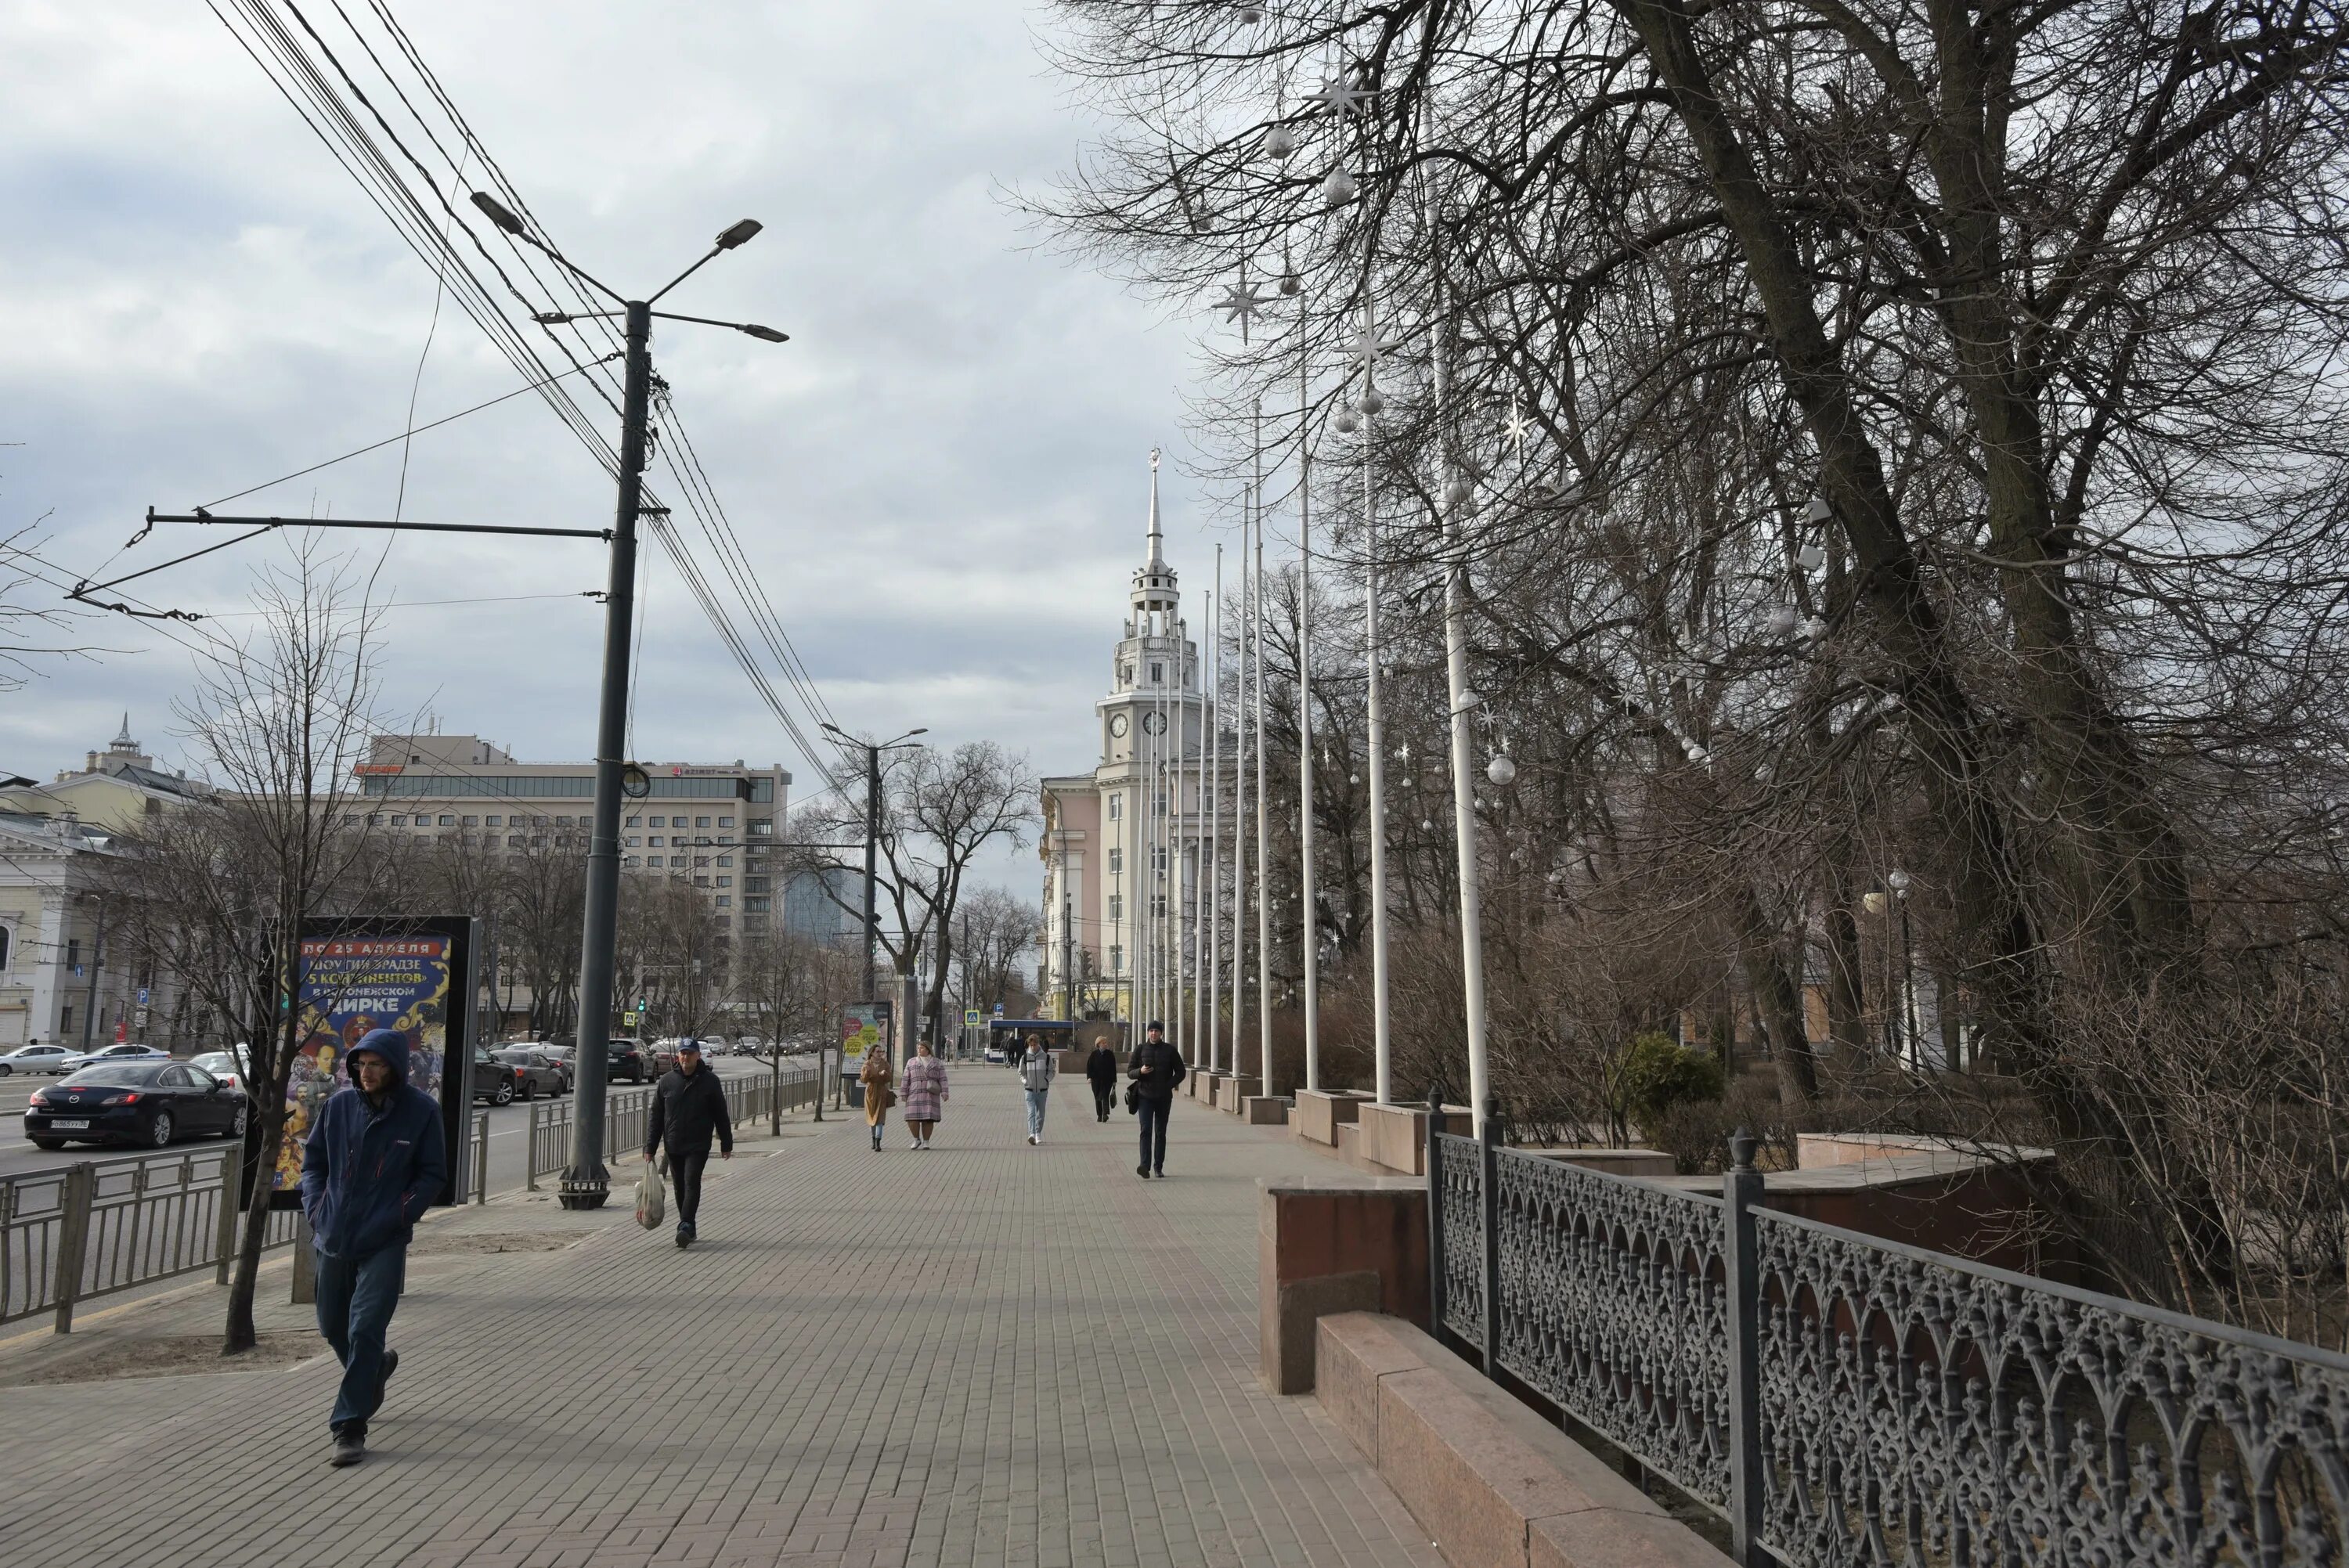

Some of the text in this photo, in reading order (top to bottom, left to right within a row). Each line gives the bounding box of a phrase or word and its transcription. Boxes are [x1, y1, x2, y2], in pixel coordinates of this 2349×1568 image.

[304, 944, 430, 953] ПО 25 АПРЕЛЯ
[309, 960, 342, 970] ШОУ
[327, 998, 399, 1015] ЦИРКЕ
